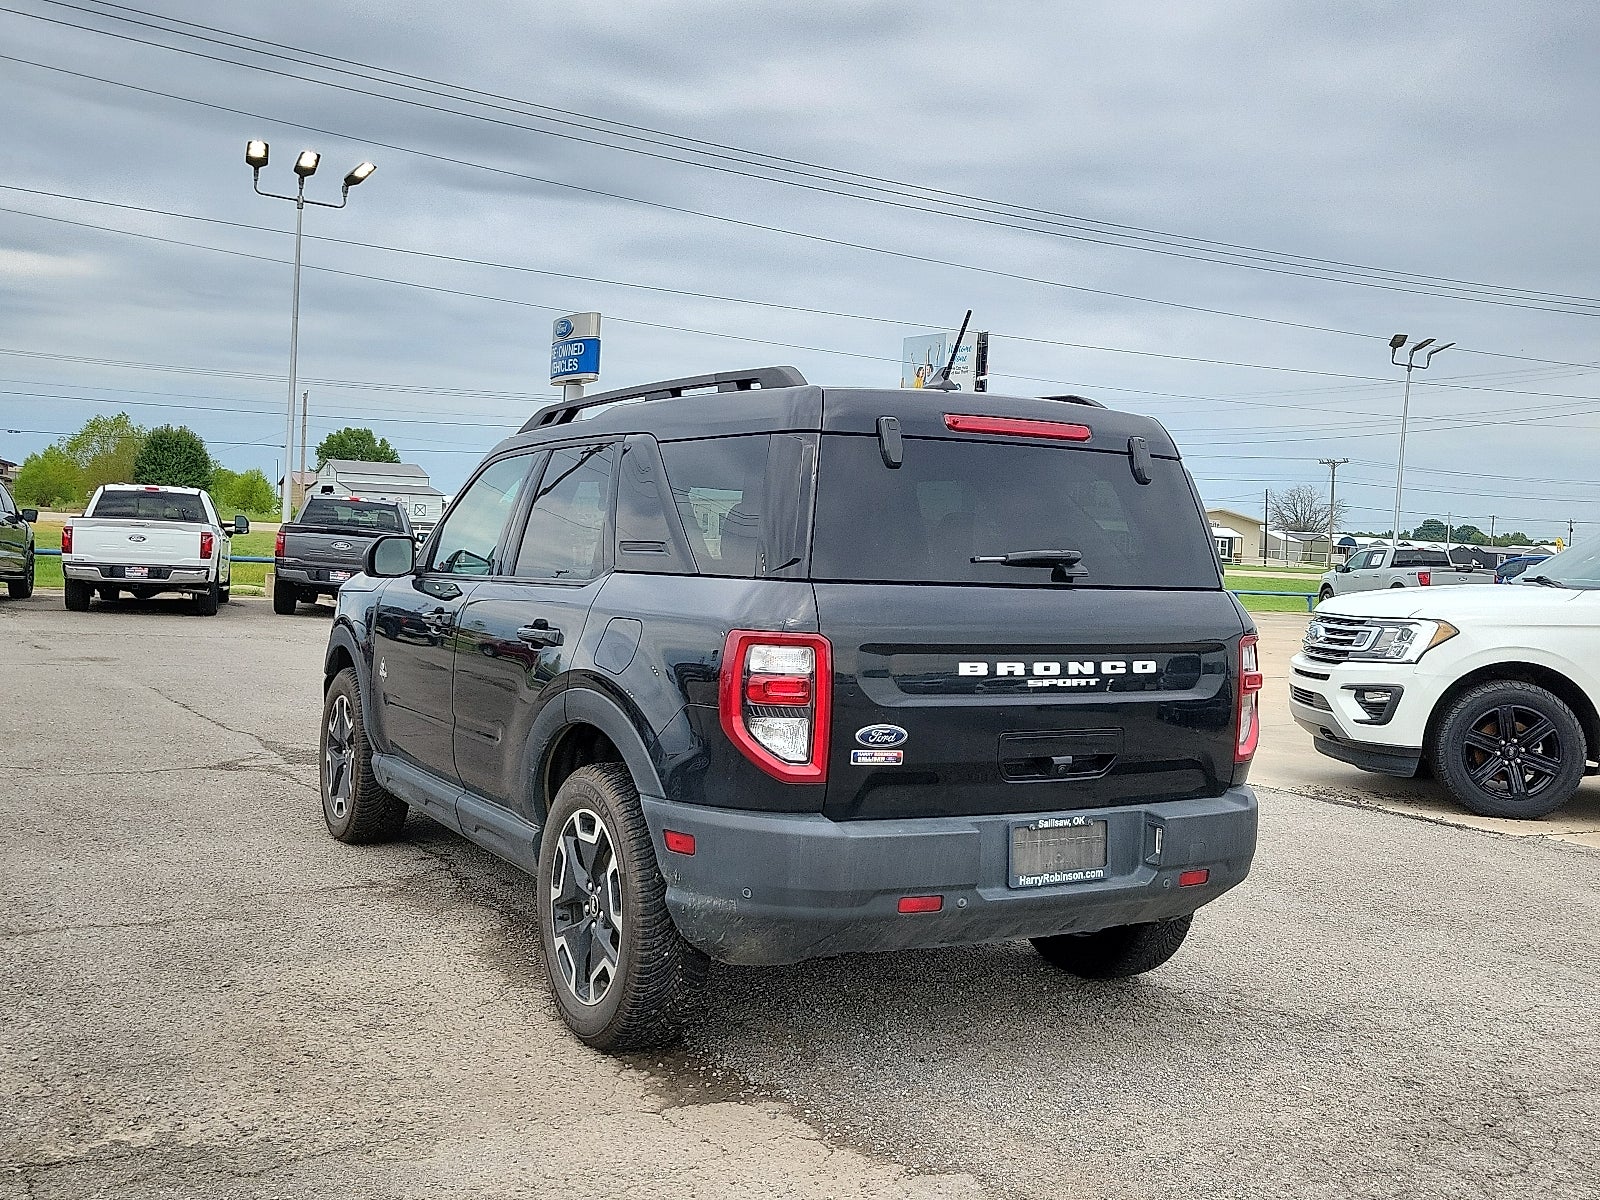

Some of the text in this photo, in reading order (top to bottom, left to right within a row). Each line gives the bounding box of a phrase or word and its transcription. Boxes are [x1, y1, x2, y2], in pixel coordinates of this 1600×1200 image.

[958, 660, 1157, 676] BRONCO
[1027, 678, 1100, 687] SPORT
[868, 729, 897, 742] Ford
[1038, 815, 1086, 828] Sallisaw, OK
[1019, 869, 1104, 886] HarryRobinson.com
